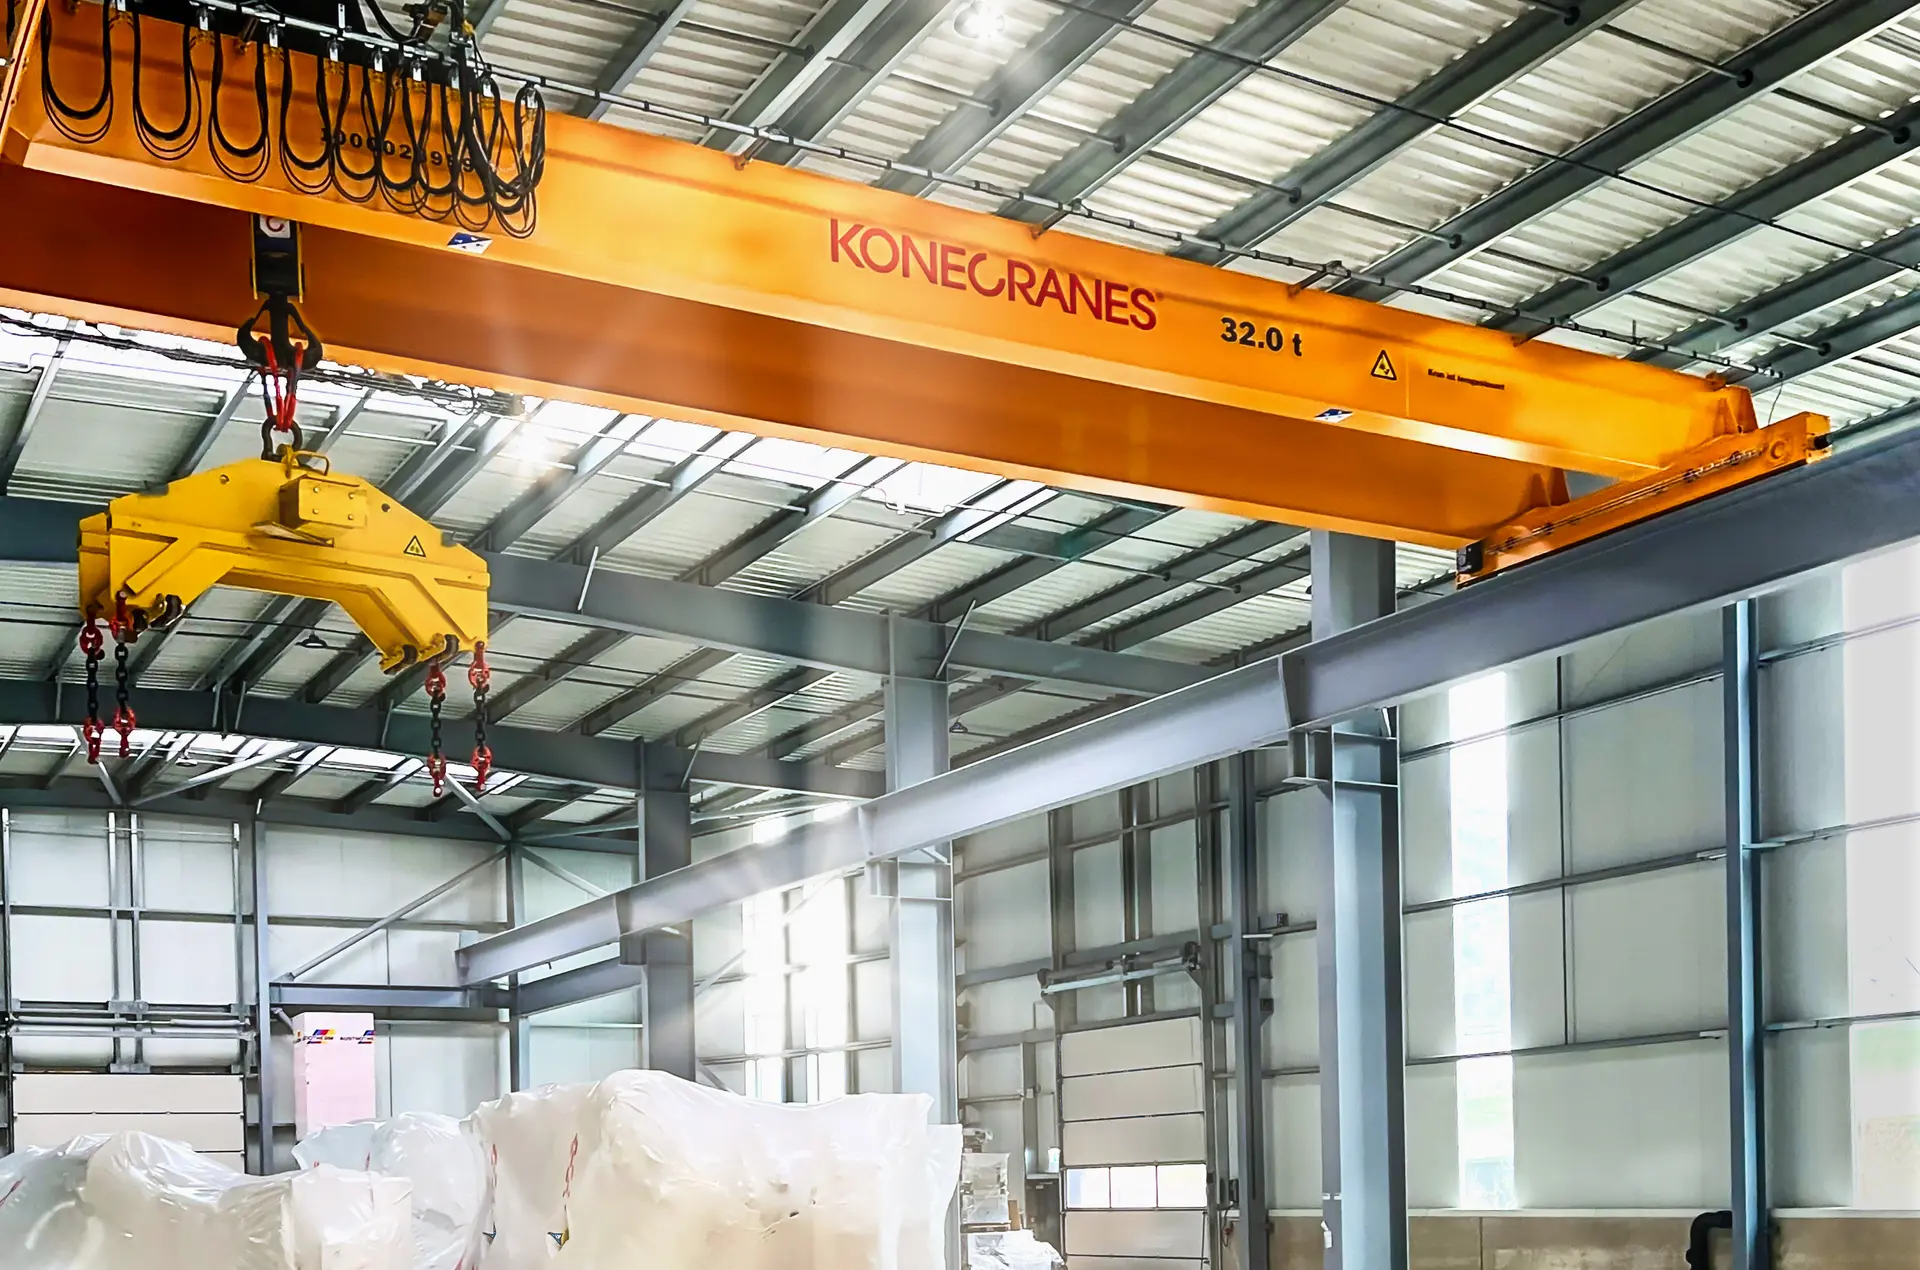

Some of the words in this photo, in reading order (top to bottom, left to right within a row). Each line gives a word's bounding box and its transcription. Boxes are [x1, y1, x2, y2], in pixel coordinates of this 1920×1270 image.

[830, 218, 1157, 331] KONECRANES
[1220, 316, 1284, 352] 32.0
[1292, 333, 1303, 357] t
